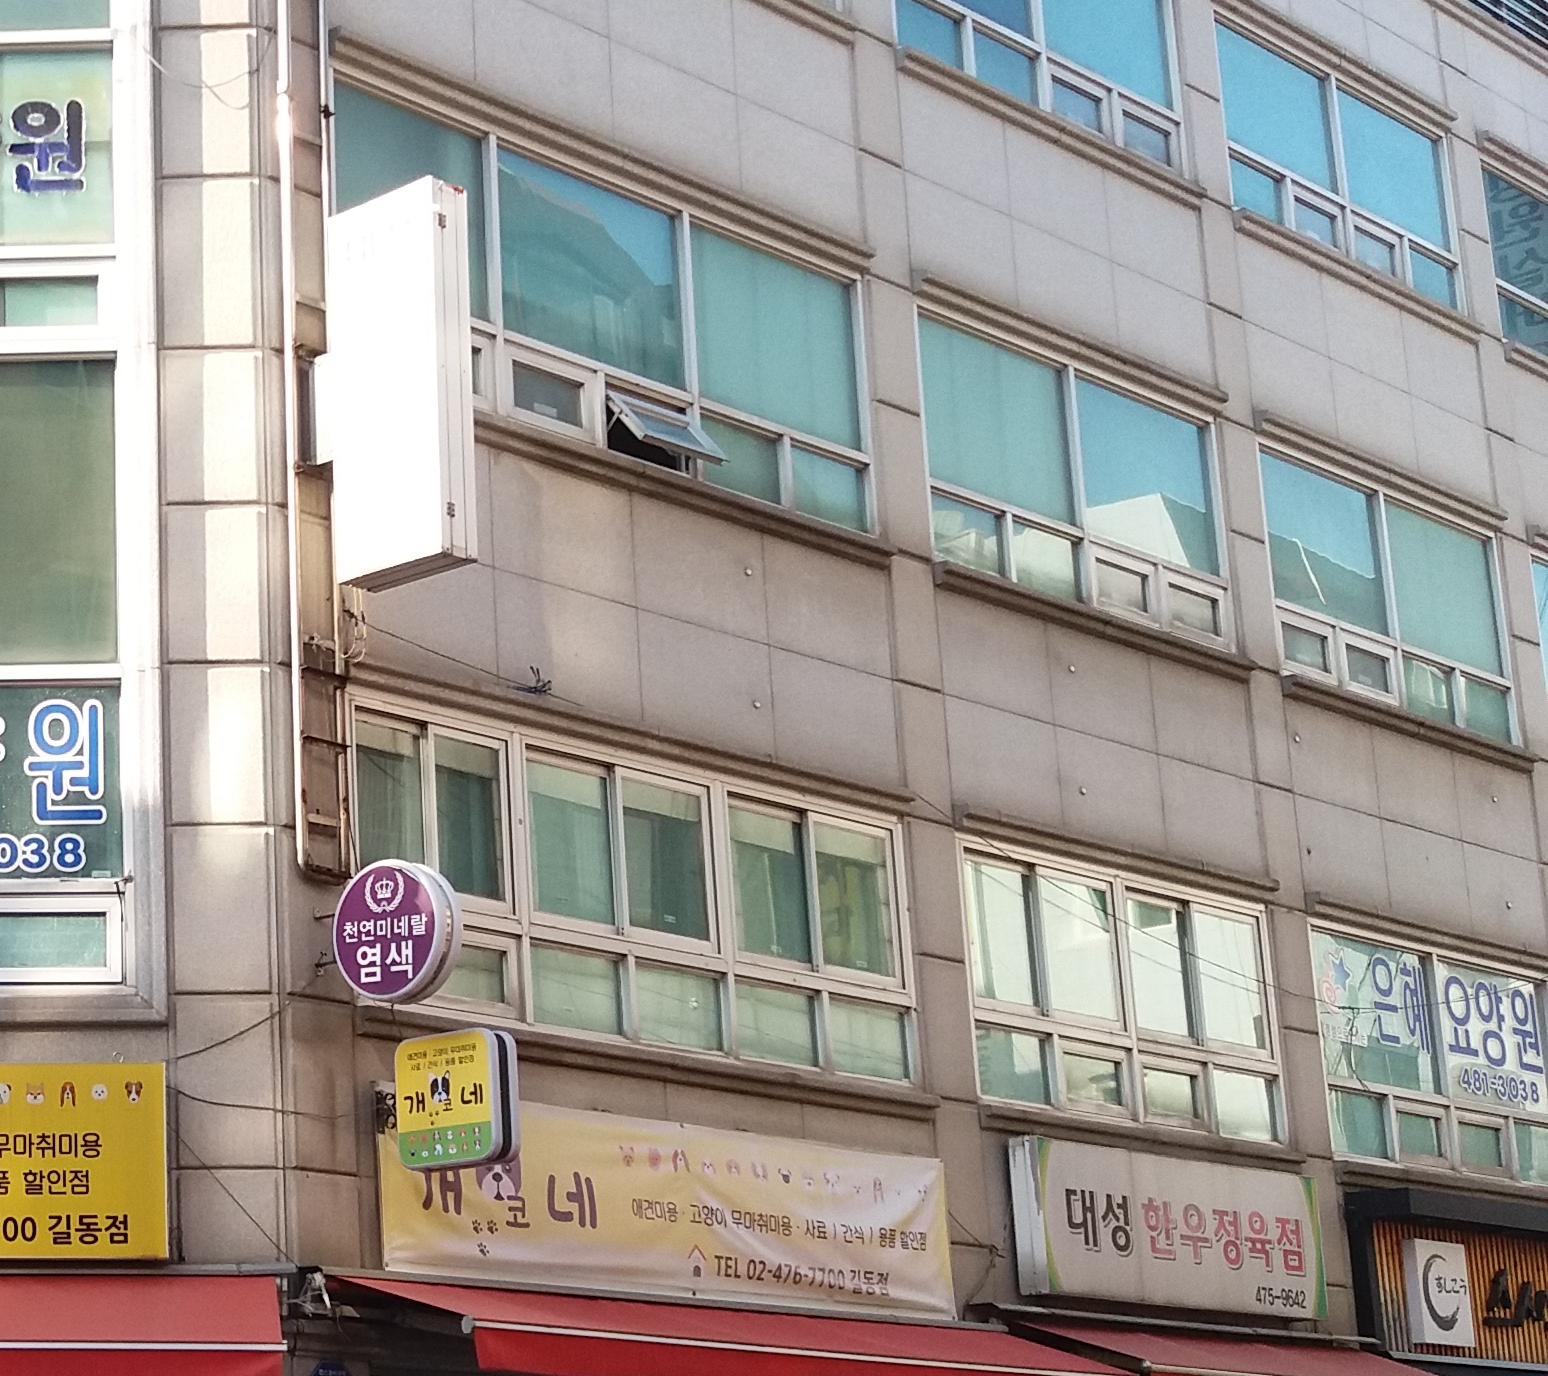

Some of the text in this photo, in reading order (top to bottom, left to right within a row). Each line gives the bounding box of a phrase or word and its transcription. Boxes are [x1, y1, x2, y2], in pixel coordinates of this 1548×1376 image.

[341, 914, 428, 944] 천연미네랄
[355, 939, 415, 984] 염색
[1371, 953, 1544, 1075] 은혜 요양원
[1460, 1067, 1540, 1104] 481-3038
[22, 1170, 91, 1197] 할인점
[47, 1213, 130, 1246] 길동점
[631, 1199, 928, 1253] 애견미용 고양이 무마취미용 사료 간식 용품 할인점
[1064, 1187, 1307, 1277] 대성 한우정육점
[714, 1255, 890, 1297] TEL 02-476-7700 길동점
[1255, 1285, 1307, 1309] 475-9642
